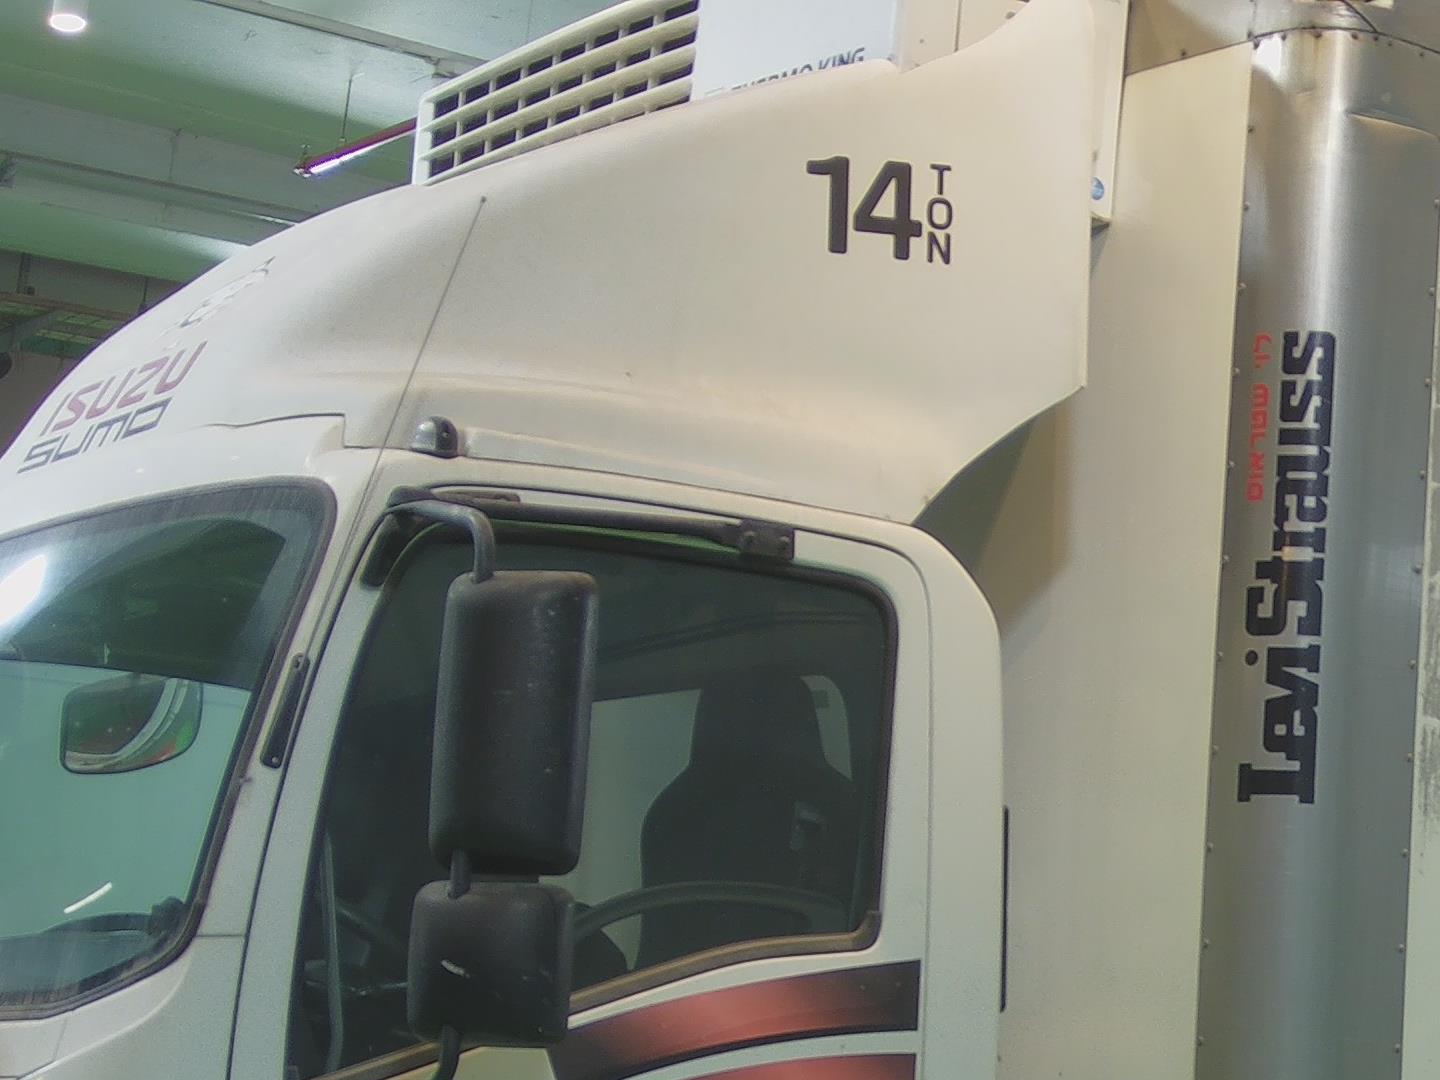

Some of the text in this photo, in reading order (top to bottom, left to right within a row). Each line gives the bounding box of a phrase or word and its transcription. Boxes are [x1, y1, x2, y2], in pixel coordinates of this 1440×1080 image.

[806, 155, 953, 265] 14 TON
[40, 340, 208, 437] ISUZU
[1247, 382, 1271, 503] שטראוס
[1236, 330, 1337, 804] Levi Strauss
